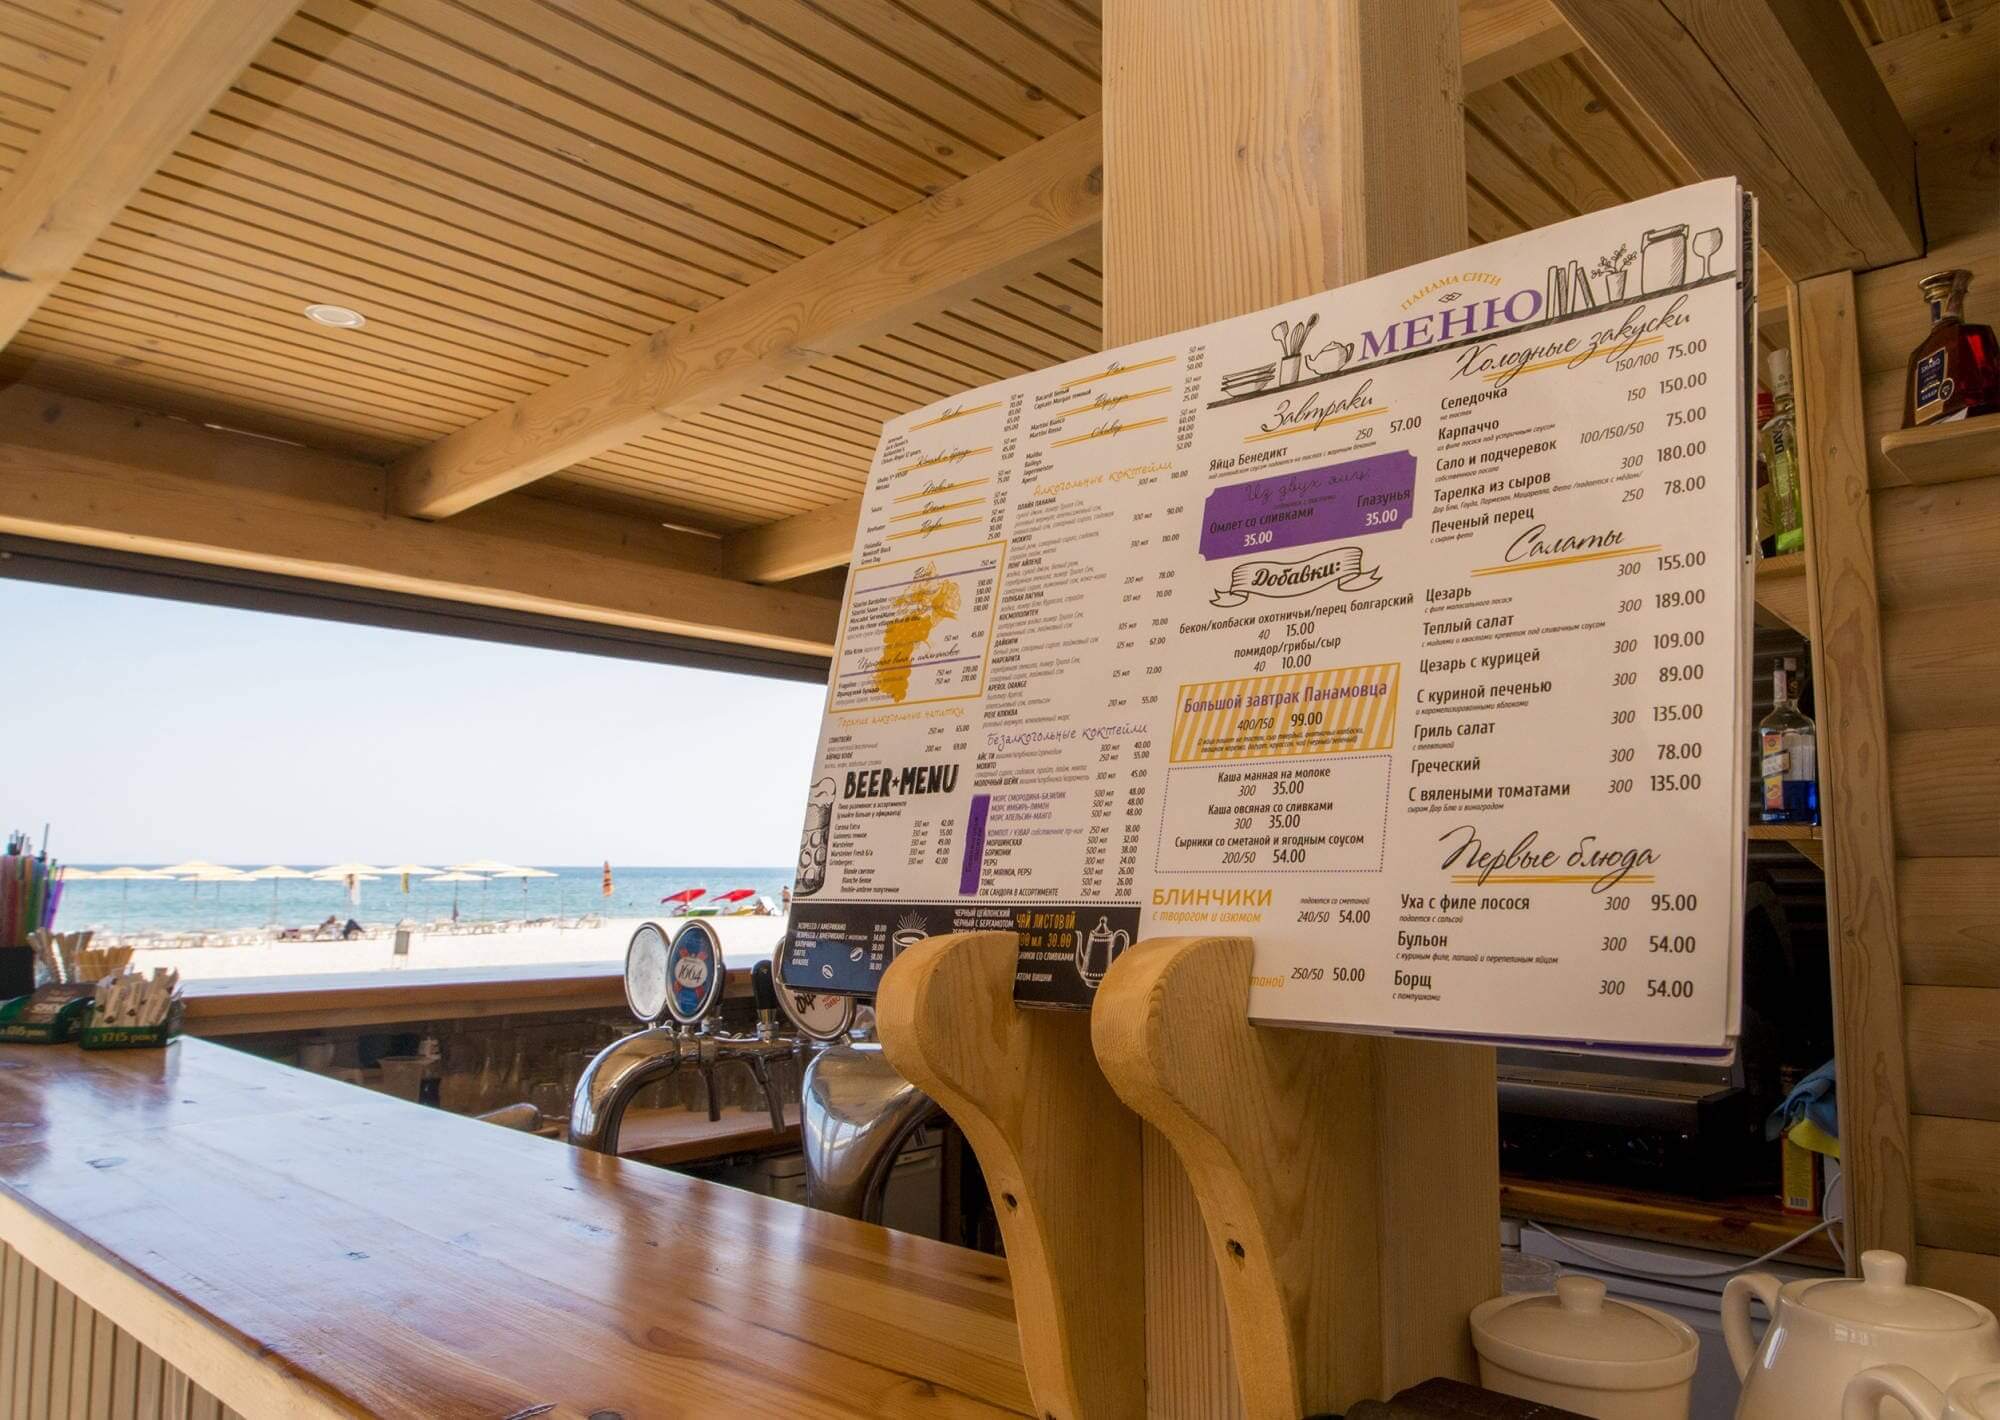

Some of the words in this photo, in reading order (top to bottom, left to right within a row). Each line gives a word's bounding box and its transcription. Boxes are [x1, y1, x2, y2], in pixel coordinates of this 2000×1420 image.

[1357, 288, 1543, 361] МЕНЮ
[1450, 343, 1581, 388] Холодные
[1567, 294, 1691, 370] закуски
[1616, 351, 1659, 373] 150/100
[1668, 339, 1707, 360] 75.00
[1627, 387, 1646, 401] 150
[1660, 372, 1707, 394] 150.00
[1261, 378, 1373, 432] Завтраки
[1441, 387, 1508, 410] Селедочка
[1355, 428, 1372, 440] 250
[1390, 416, 1422, 434] 57.00
[1438, 419, 1500, 442] Карпаччо
[1580, 421, 1644, 445] 100/150/50
[1666, 407, 1707, 427] 75.00
[1209, 454, 1235, 471] Яйца
[1238, 447, 1287, 466] Бенедикт
[1436, 456, 1465, 472] Сало
[1468, 455, 1476, 465] и
[1480, 440, 1557, 465] подчеревок
[1621, 454, 1643, 469] 300
[1657, 441, 1706, 462] 180.00
[1434, 484, 1485, 502] Тарелка
[1489, 481, 1504, 494] из
[1508, 472, 1551, 493] сыров
[1622, 488, 1644, 504] 250
[1664, 475, 1706, 497] 78.00
[1357, 489, 1411, 508] Глазунья
[1210, 520, 1241, 534] Омлет
[1245, 518, 1257, 528] со
[1260, 507, 1314, 523] сливками
[1366, 509, 1397, 526] 35.00
[1431, 513, 1490, 535] Печеный
[1494, 506, 1535, 526] перец
[1243, 531, 1272, 547] 35.00
[1504, 523, 1624, 563] Салаты
[1251, 561, 1341, 587] Добавки:
[1617, 563, 1641, 577] 300
[1658, 551, 1706, 572] 155.00
[1426, 587, 1472, 603] Цезарь
[1618, 599, 1642, 613] 300
[1655, 589, 1705, 609] 189.00
[1179, 615, 1255, 634] бекон/колбаски
[1258, 605, 1347, 625] охотничьи/перец
[1351, 594, 1414, 611] болгарский
[1258, 629, 1270, 641] 40
[1286, 622, 1315, 637] 15.00
[1423, 620, 1472, 637] Теплый
[1477, 615, 1515, 629] салат
[1234, 637, 1341, 658] помидор/грибы/сыр
[1613, 640, 1638, 654] 300
[1653, 630, 1705, 650] 109.00
[1253, 661, 1265, 672] 40
[1282, 654, 1311, 669] 10.00
[1420, 660, 1466, 675] Цезарь
[1470, 658, 1476, 668] с
[1481, 649, 1540, 670] курицей
[1612, 672, 1637, 687] 300
[1659, 664, 1704, 682] 89.00
[1184, 697, 1242, 713] Большой
[1246, 689, 1300, 709] завтрак
[1304, 683, 1387, 702] Панамовца
[1417, 690, 1424, 703] С
[1428, 684, 1486, 706] куриной
[1490, 681, 1552, 697] печенью
[1237, 718, 1274, 731] 400/150
[1291, 712, 1322, 727] 99.00
[1611, 710, 1636, 724] 300
[1653, 704, 1703, 722] 135.00
[1082, 724, 1147, 738] коктейли
[1414, 724, 1452, 742] Гриль
[1457, 721, 1496, 736] салат
[1610, 748, 1634, 763] 300
[1657, 742, 1702, 760] 78.00
[1218, 771, 1242, 783] Каша
[1244, 770, 1278, 781] манная
[1281, 770, 1292, 779] на
[1296, 768, 1330, 778] молоке
[1411, 757, 1480, 776] Греческий
[844, 768, 893, 799] BEER
[900, 765, 959, 795] MENU
[1238, 785, 1256, 797] 300
[1272, 780, 1304, 795] 35.00
[1408, 788, 1417, 801] С
[1420, 784, 1493, 801] вялеными
[1498, 783, 1570, 798] томатами
[1608, 779, 1632, 793] 300
[1650, 774, 1701, 792] 135.00
[1208, 804, 1231, 815] Каша
[1234, 803, 1270, 814] овсяная
[1273, 804, 1283, 812] со
[1286, 802, 1333, 812] сливками
[1234, 818, 1252, 830] 300
[1269, 814, 1300, 829] 35.00
[1175, 836, 1212, 850] Сырники
[1216, 837, 1225, 847] со
[1228, 835, 1270, 847] сметаной
[1273, 837, 1279, 845] и
[1282, 835, 1325, 848] ягодным
[1329, 835, 1364, 848] соусом
[1222, 852, 1256, 864] 200/50
[1272, 849, 1306, 863] 54.00
[1438, 825, 1560, 886] Первые
[1567, 836, 1661, 894] блюда
[1017, 868, 1032, 876] PEPSI
[1115, 888, 1131, 896] 20.00
[1152, 889, 1272, 907] БЛИНЧИКИ
[1604, 897, 1630, 910] 300
[1651, 894, 1697, 911] 95.00
[1401, 893, 1423, 909] Уха
[1429, 897, 1435, 908] с
[1440, 893, 1476, 913] филе
[1480, 896, 1530, 910] лосося
[1034, 911, 1077, 929] ЛИСТОВОЙ
[1212, 913, 1218, 921] и
[1297, 911, 1329, 924] 240/50
[1339, 910, 1370, 924] 54.00
[1397, 931, 1448, 947] Бульон
[1601, 937, 1627, 951] 300
[1649, 936, 1696, 953] 54.00
[1291, 968, 1323, 980] 250/50
[1333, 968, 1365, 982] 50.00
[1394, 971, 1431, 990] Борщ
[1599, 981, 1624, 995] 300
[1647, 980, 1693, 998] 54.00
